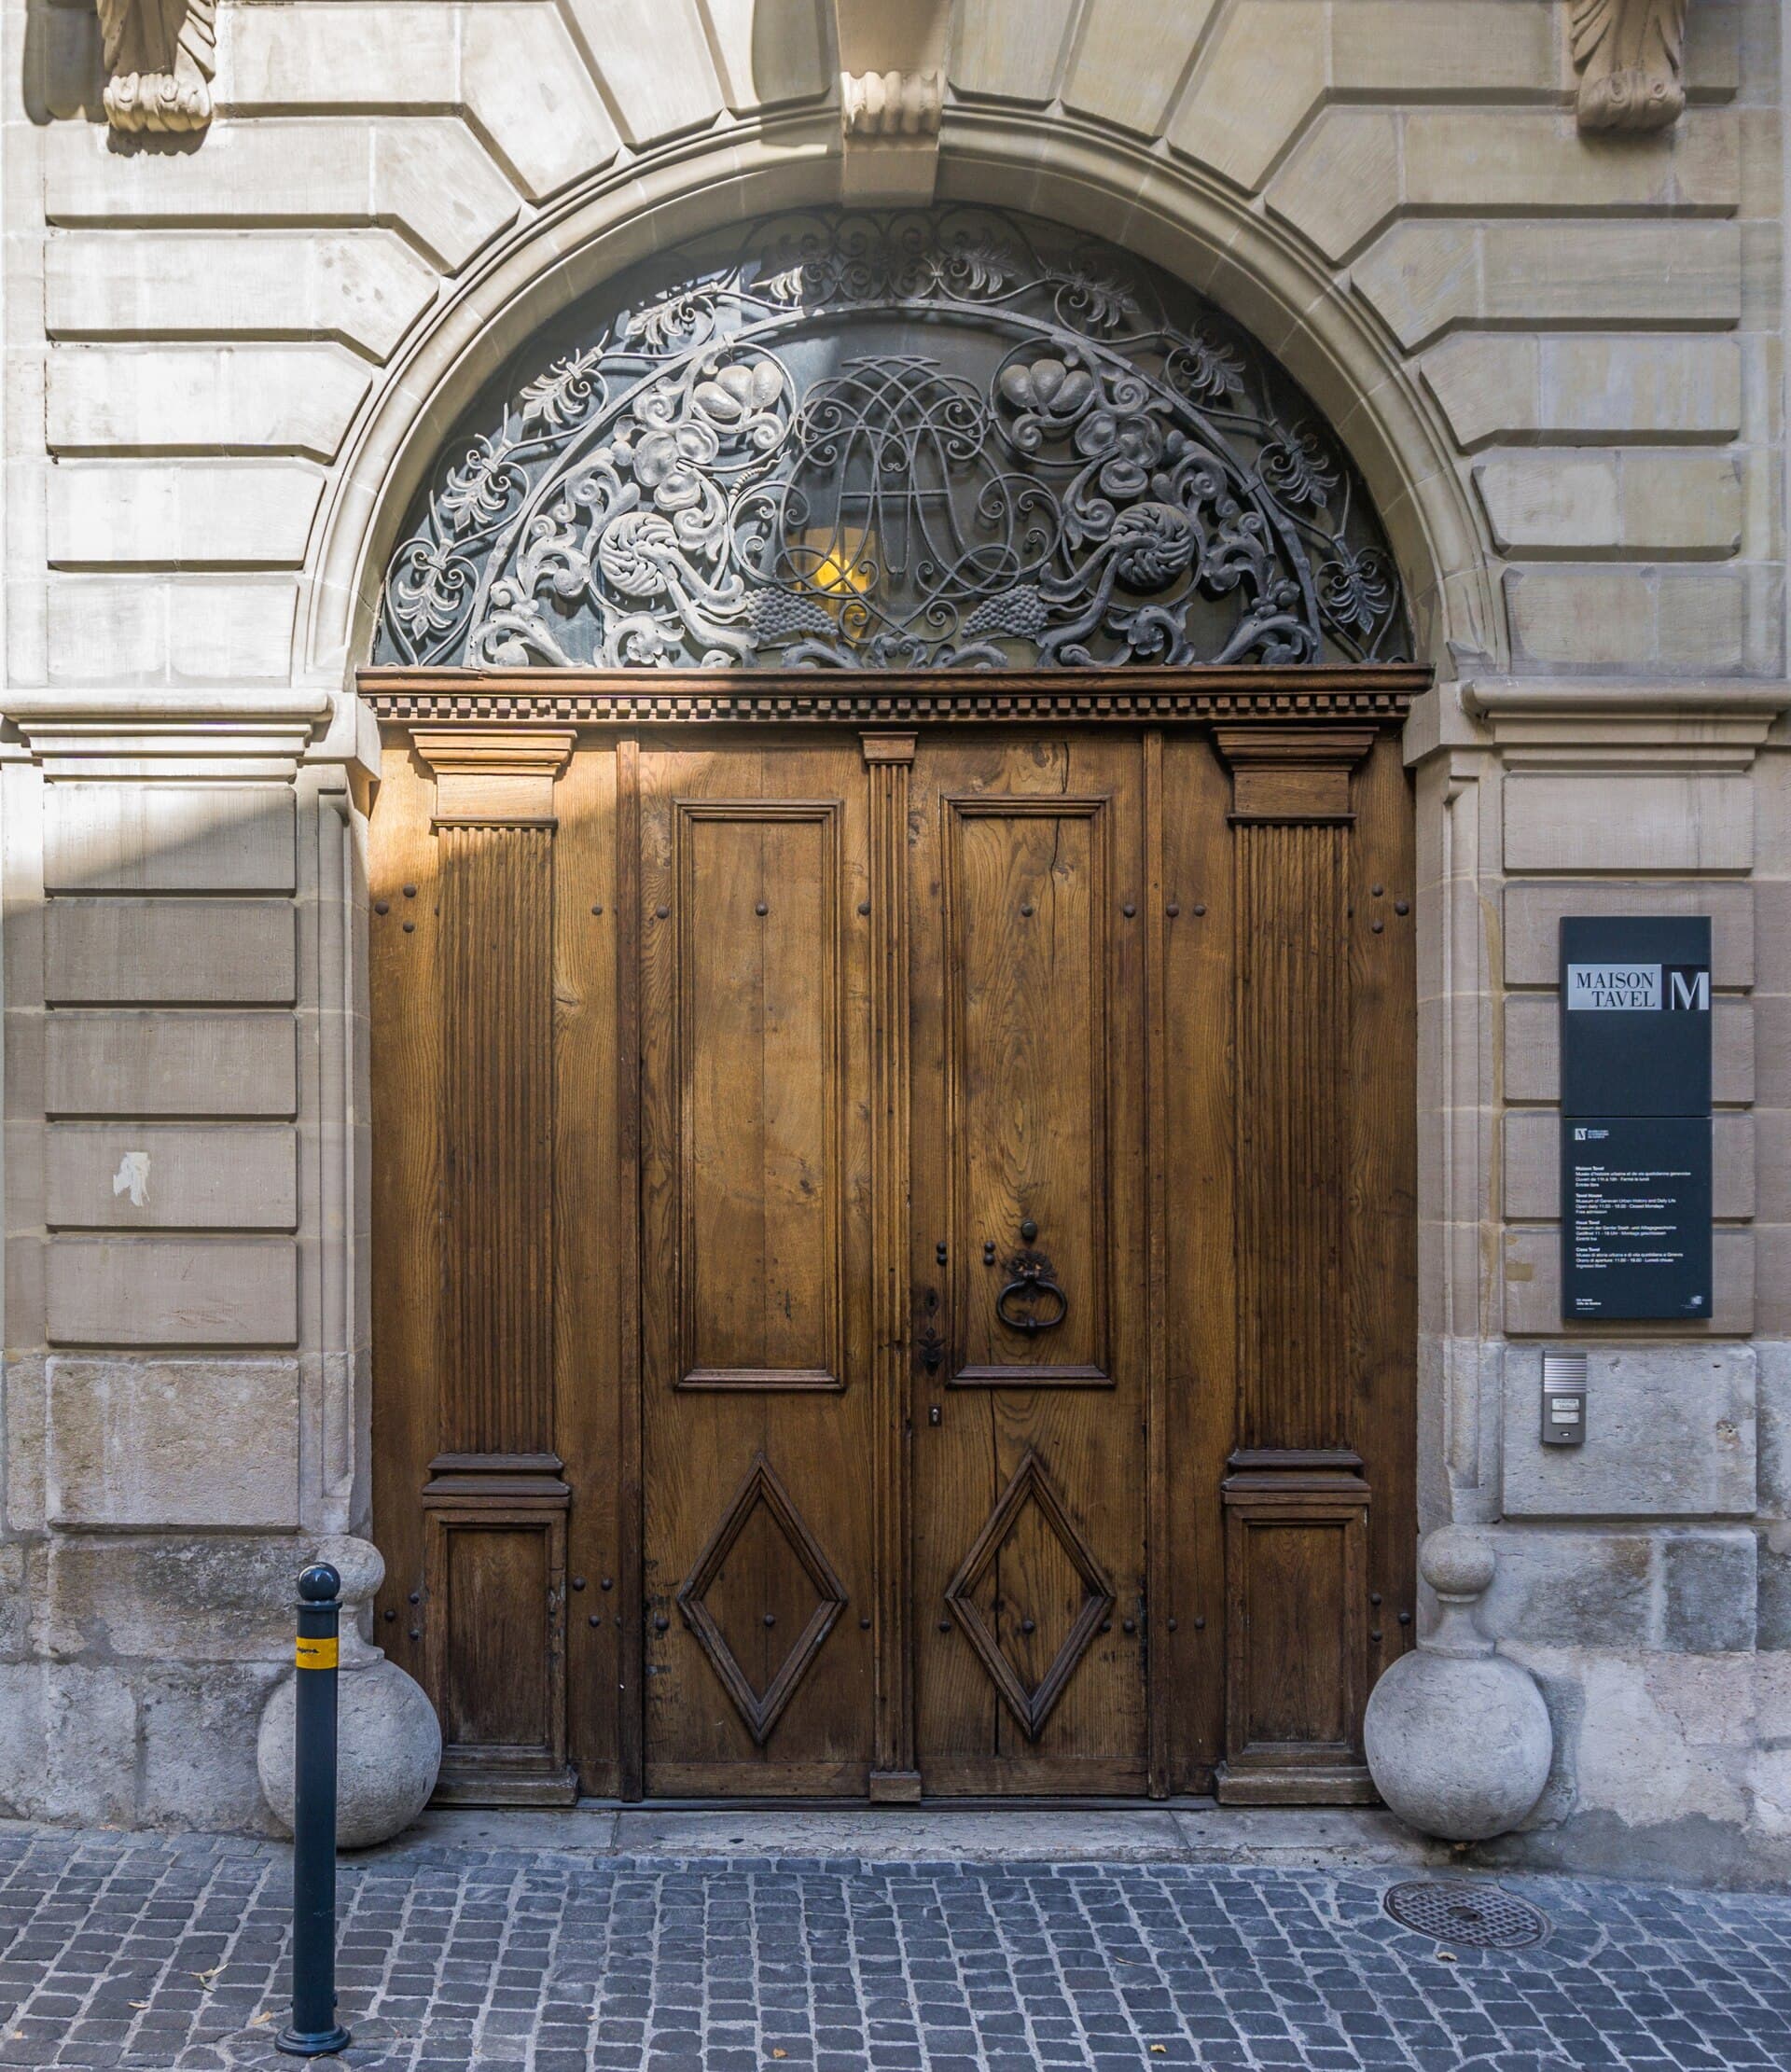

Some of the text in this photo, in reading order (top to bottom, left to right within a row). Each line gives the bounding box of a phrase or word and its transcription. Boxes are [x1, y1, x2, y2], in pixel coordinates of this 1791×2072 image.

[1576, 972, 1655, 989] MAISON
[1591, 991, 1656, 1008] TAVEL
[1671, 972, 1710, 1010] M
